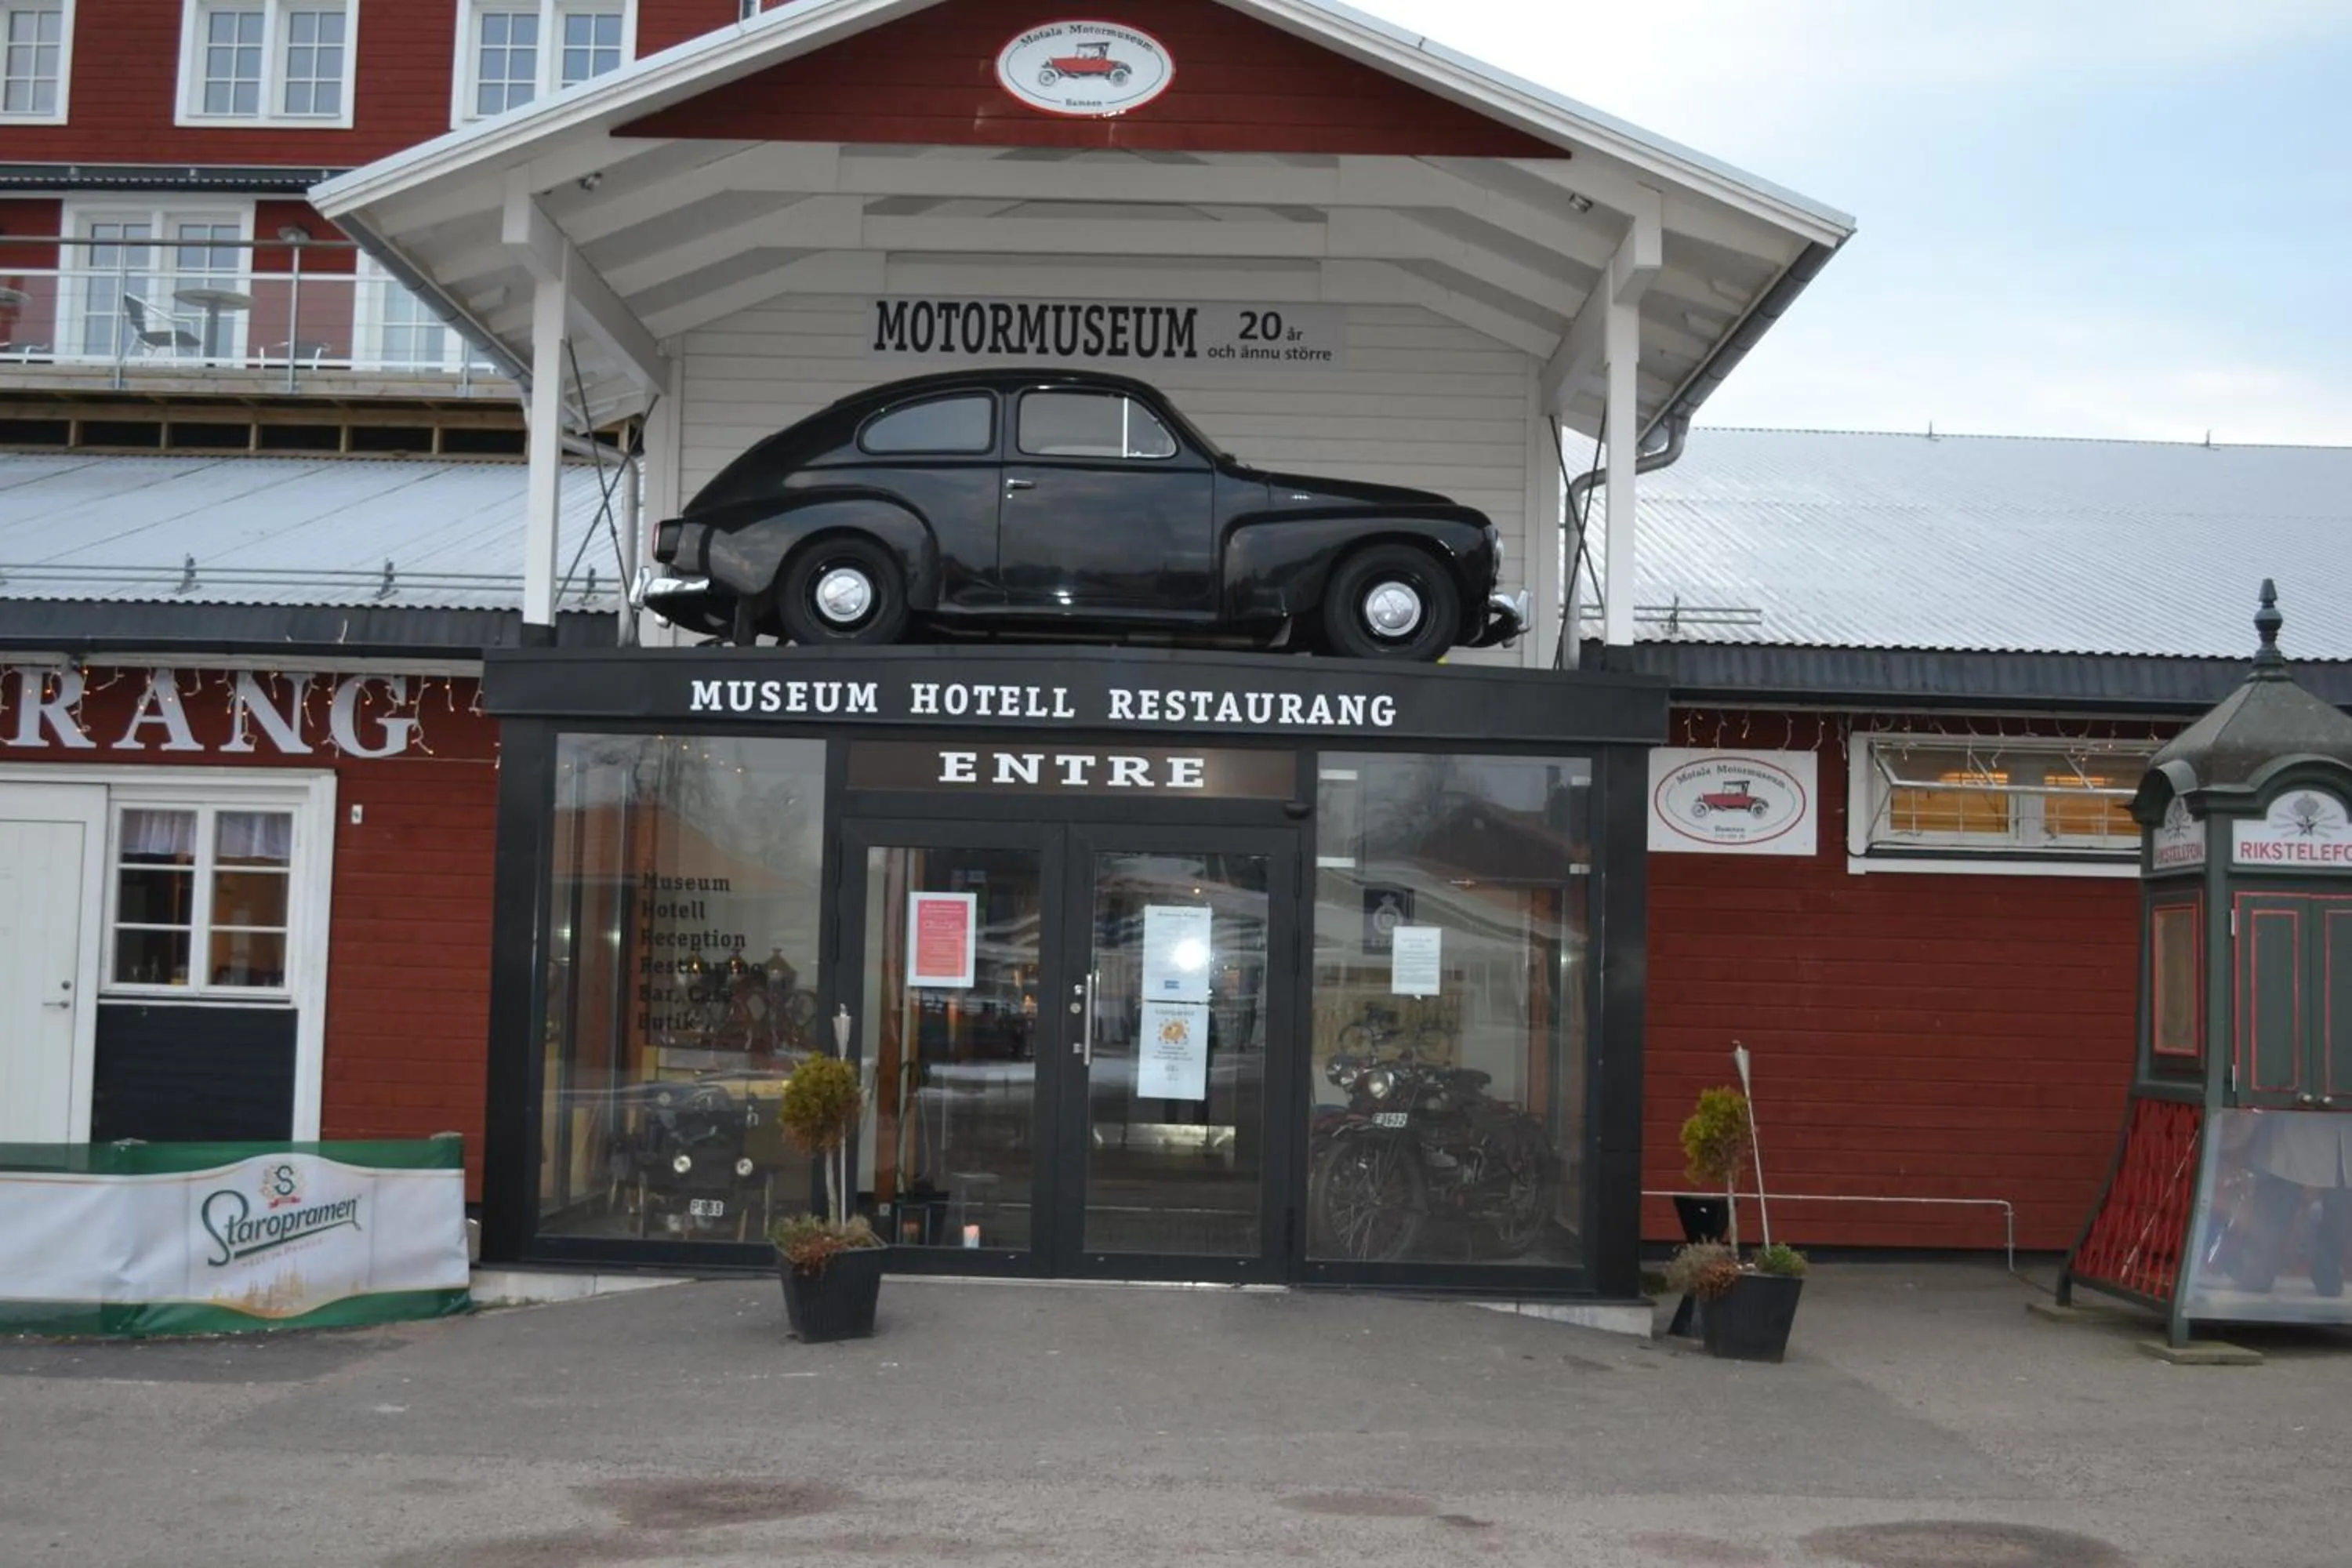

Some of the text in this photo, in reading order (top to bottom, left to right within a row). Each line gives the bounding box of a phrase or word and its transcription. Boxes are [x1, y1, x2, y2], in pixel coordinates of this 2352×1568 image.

[1020, 27, 1062, 48] Motala
[873, 301, 1198, 359] MOTORMUSEUM
[1239, 310, 1304, 341] 20 år
[1207, 344, 1333, 361] och ännu större
[4, 666, 417, 759] RANG
[689, 681, 1396, 728] MUSEUM HOTELL RESTAURANG
[938, 751, 1205, 788] ENTRE
[1675, 767, 1711, 785] Motala
[643, 872, 731, 892] Museum
[642, 901, 706, 920] Hotell
[641, 929, 746, 951] Reception
[201, 1190, 361, 1266] Staropramen
